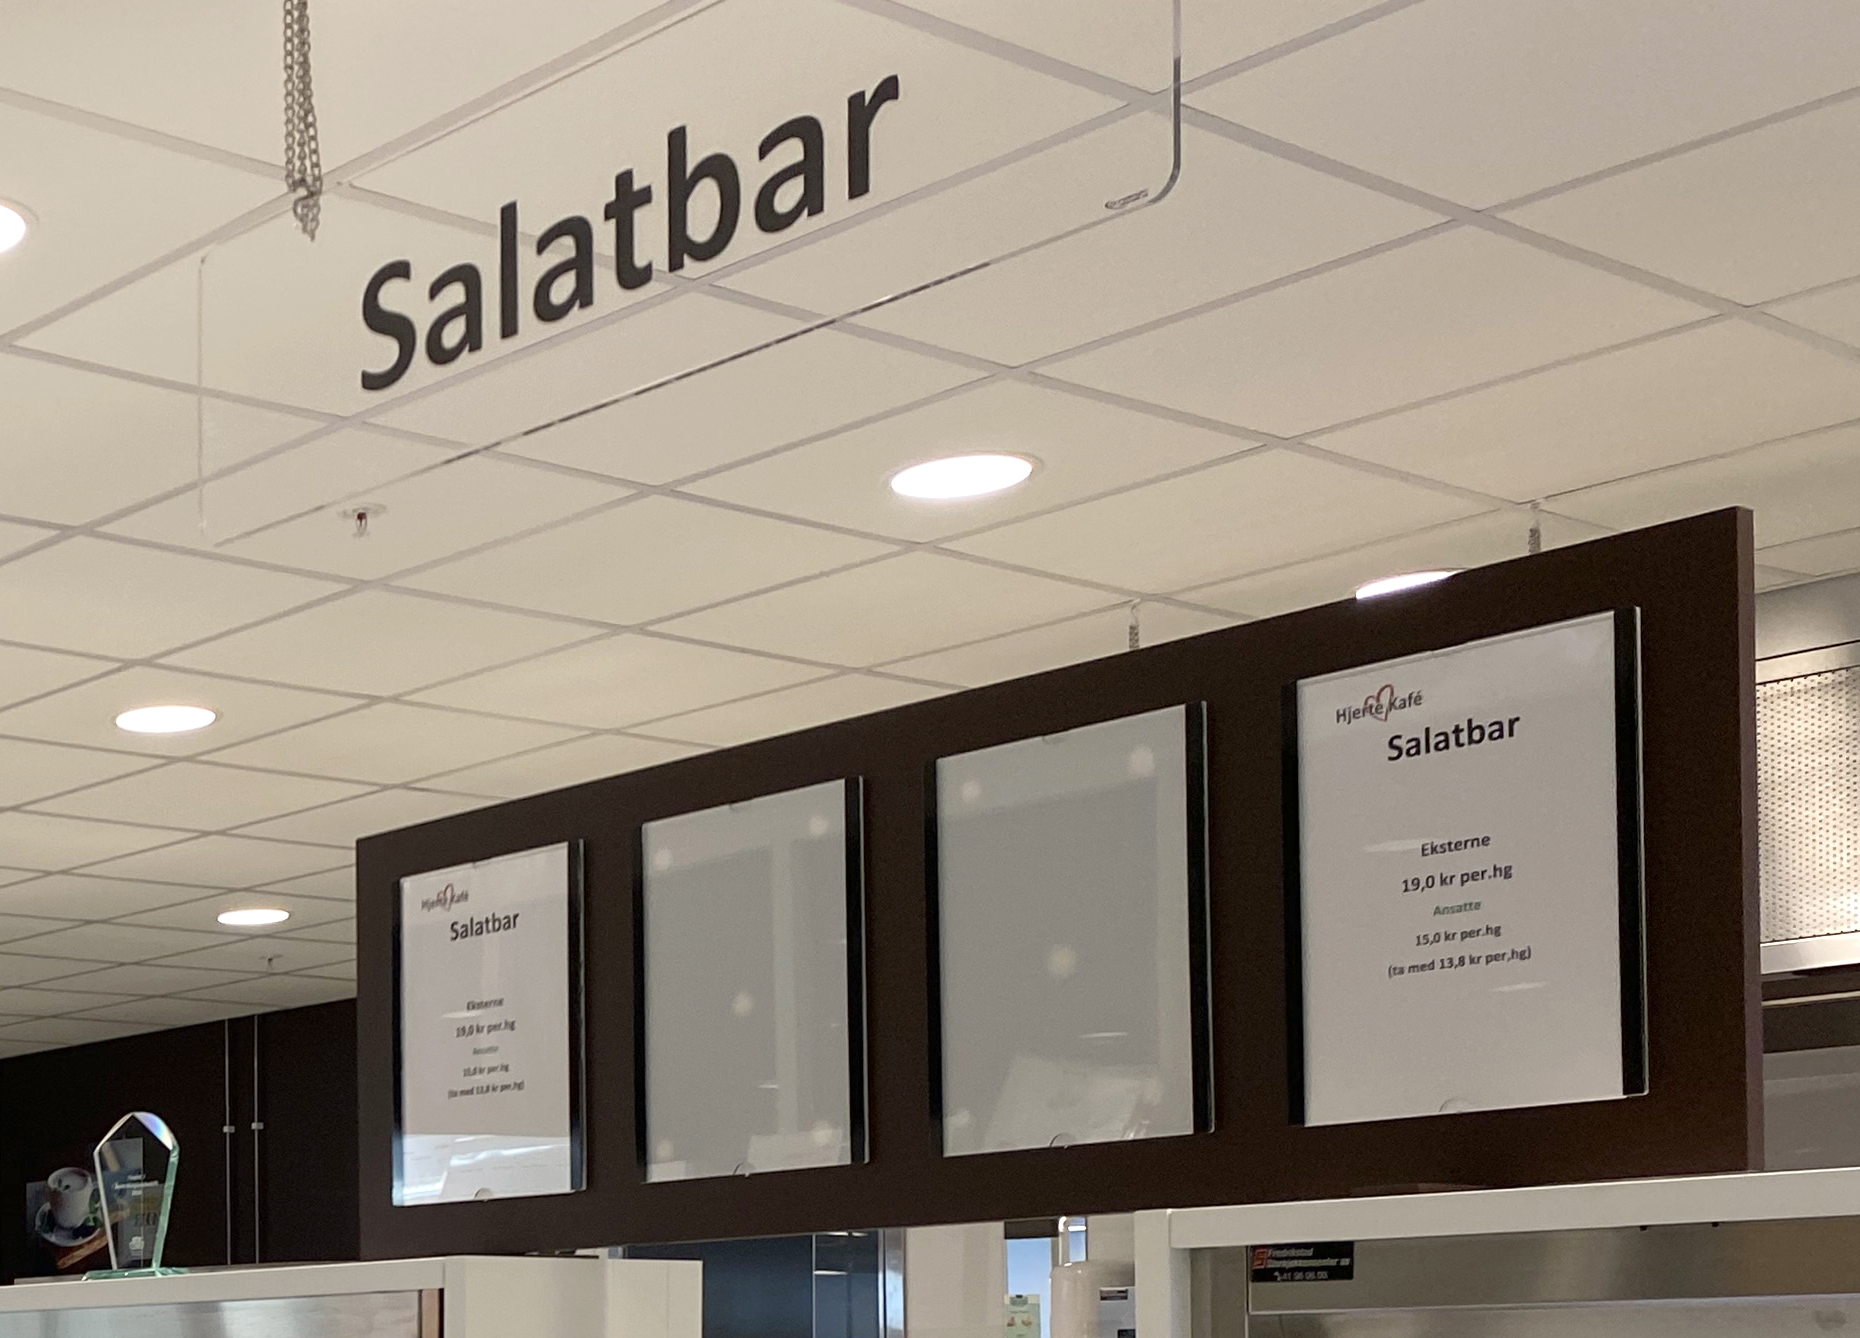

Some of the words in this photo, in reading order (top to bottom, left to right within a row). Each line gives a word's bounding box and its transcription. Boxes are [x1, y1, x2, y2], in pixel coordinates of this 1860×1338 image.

[361, 73, 900, 392] Salatbar
[1335, 701, 1384, 725] Hjerte
[1389, 690, 1423, 712] Kafé
[1387, 716, 1520, 761] Salatbar
[1421, 835, 1491, 857] Eksterne
[1402, 875, 1435, 893] 19,0
[1439, 872, 1456, 887] kr
[1433, 901, 1482, 916] Ansatte
[450, 912, 520, 942] Salatbar
[1415, 932, 1441, 947] 15,0
[1444, 930, 1457, 942] kr
[1408, 960, 1435, 974] med
[1439, 955, 1465, 970] 13,8
[1469, 954, 1482, 966] kr
